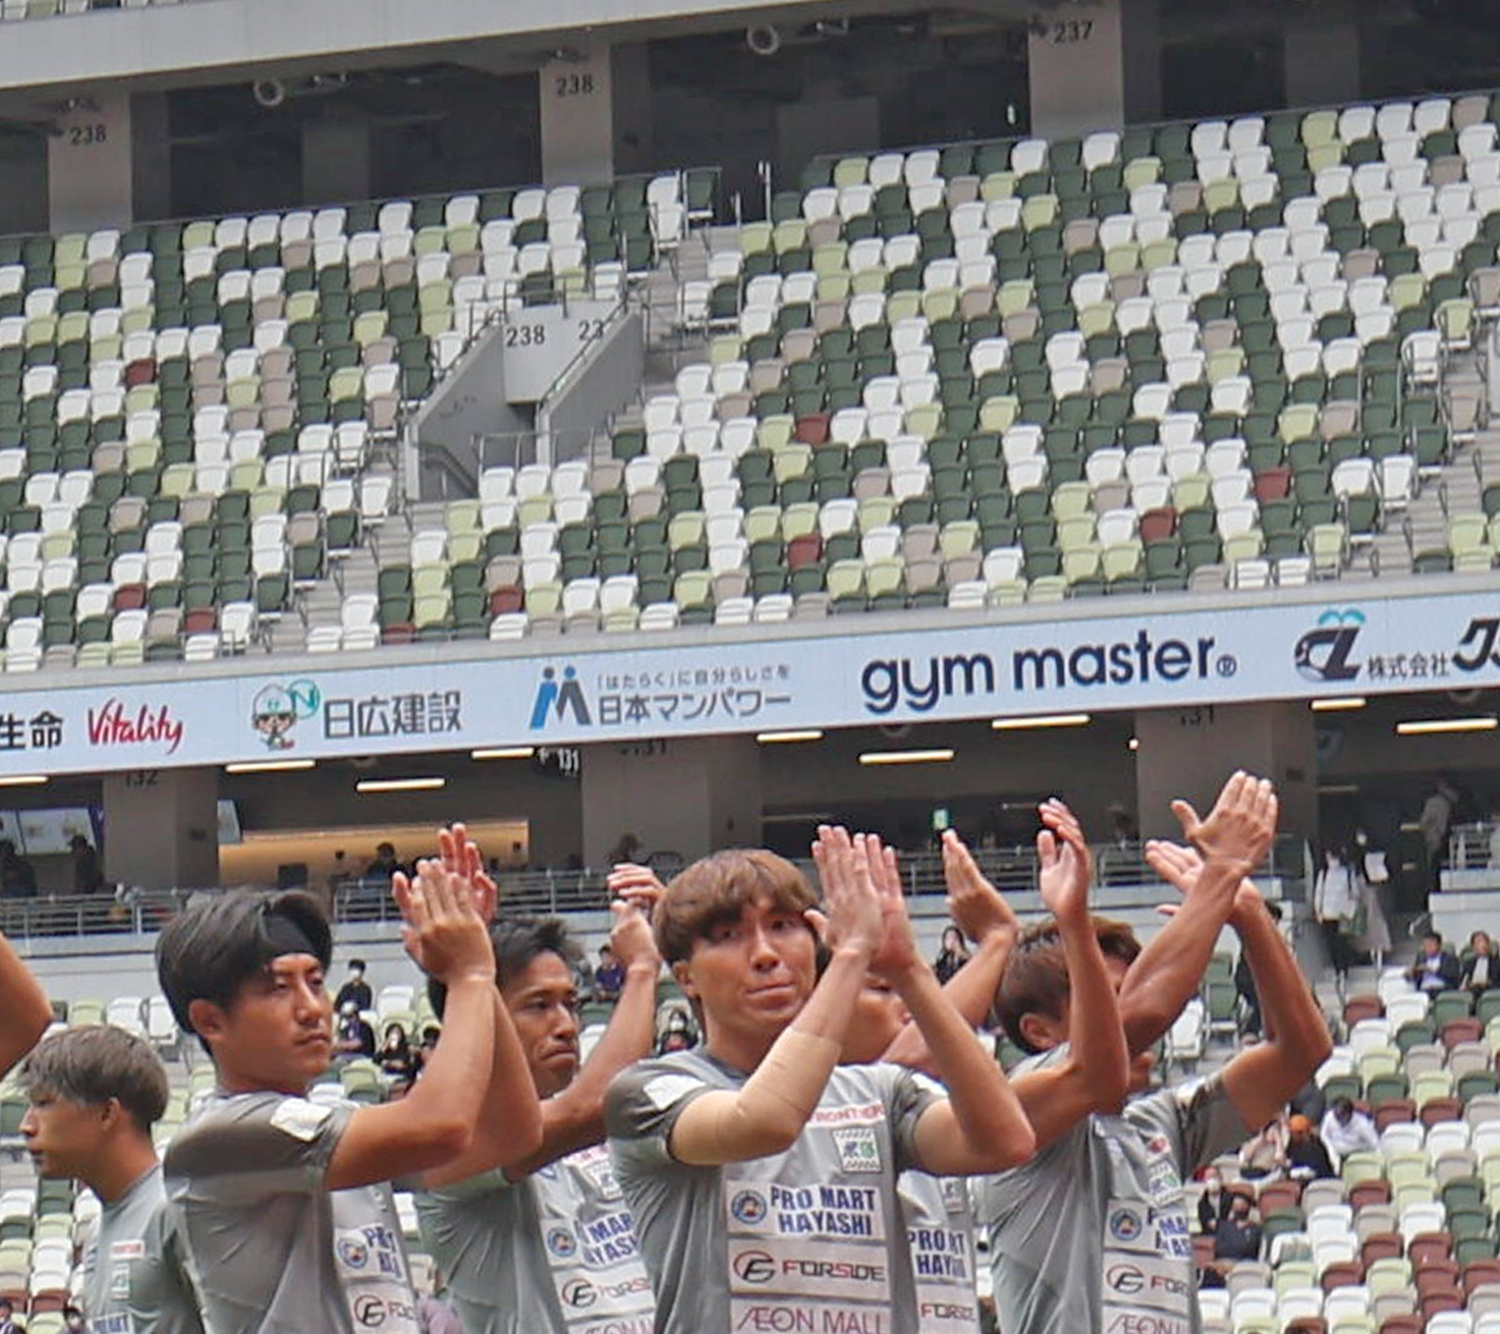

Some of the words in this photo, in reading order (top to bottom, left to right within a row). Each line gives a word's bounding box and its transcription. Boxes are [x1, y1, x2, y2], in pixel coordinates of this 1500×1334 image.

[1053, 21, 1093, 44] 237
[69, 124, 107, 145] 238
[506, 326, 545, 347] 238
[1366, 652, 1450, 680] 株式会社
[1451, 618, 1500, 672] ク
[862, 651, 995, 715] gym
[323, 691, 462, 740] 日広建設
[599, 687, 792, 725] 日本マンパワー
[87, 697, 185, 755] Vitality
[770, 1185, 813, 1210] PRO
[819, 1185, 876, 1211] MART
[778, 1210, 872, 1236] HAYASHI
[782, 1260, 886, 1282] FORSIDE
